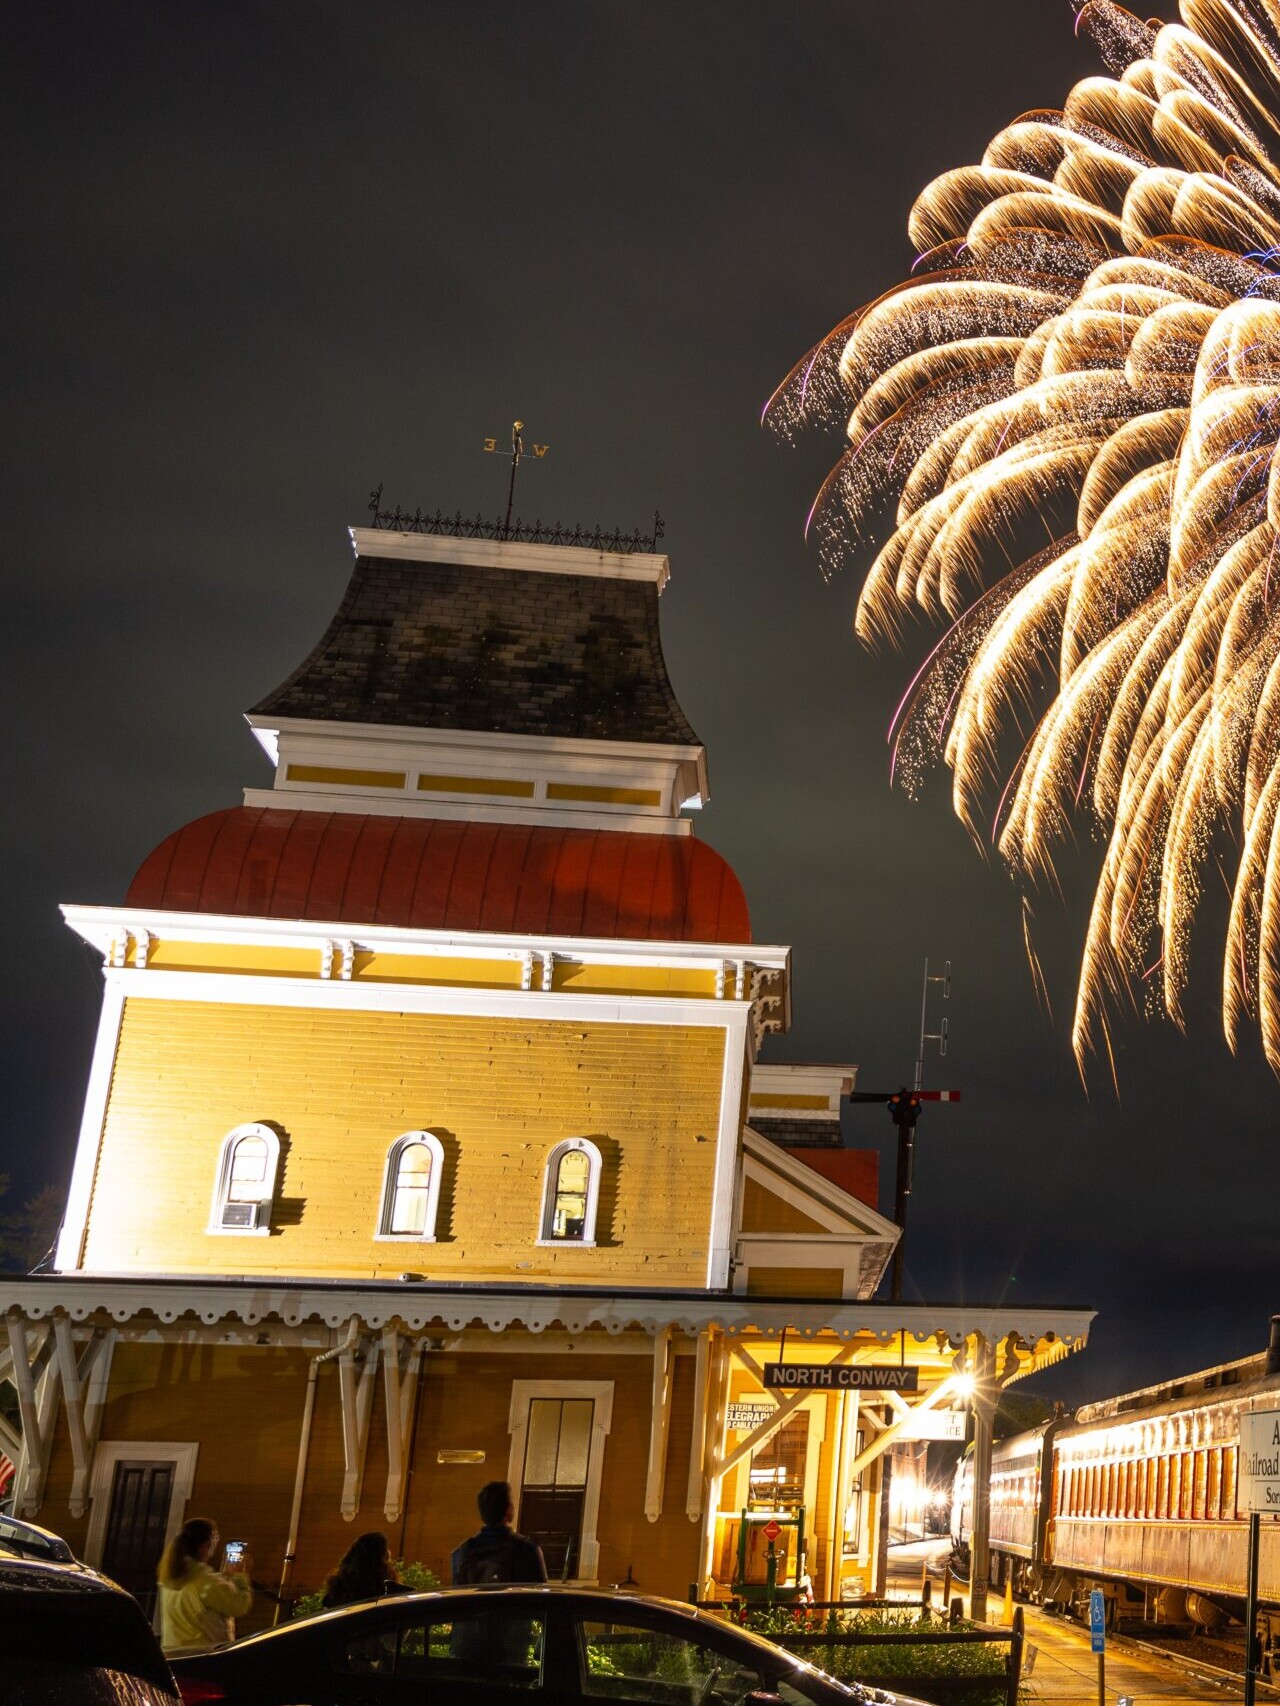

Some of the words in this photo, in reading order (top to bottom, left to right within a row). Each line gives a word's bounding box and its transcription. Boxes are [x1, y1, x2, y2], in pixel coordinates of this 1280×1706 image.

[773, 1368, 832, 1384] NORTH
[838, 1370, 909, 1386] CONWAY
[727, 1404, 752, 1412] ESTERN
[753, 1404, 774, 1412] UNION
[1241, 1450, 1279, 1476] Railroad
